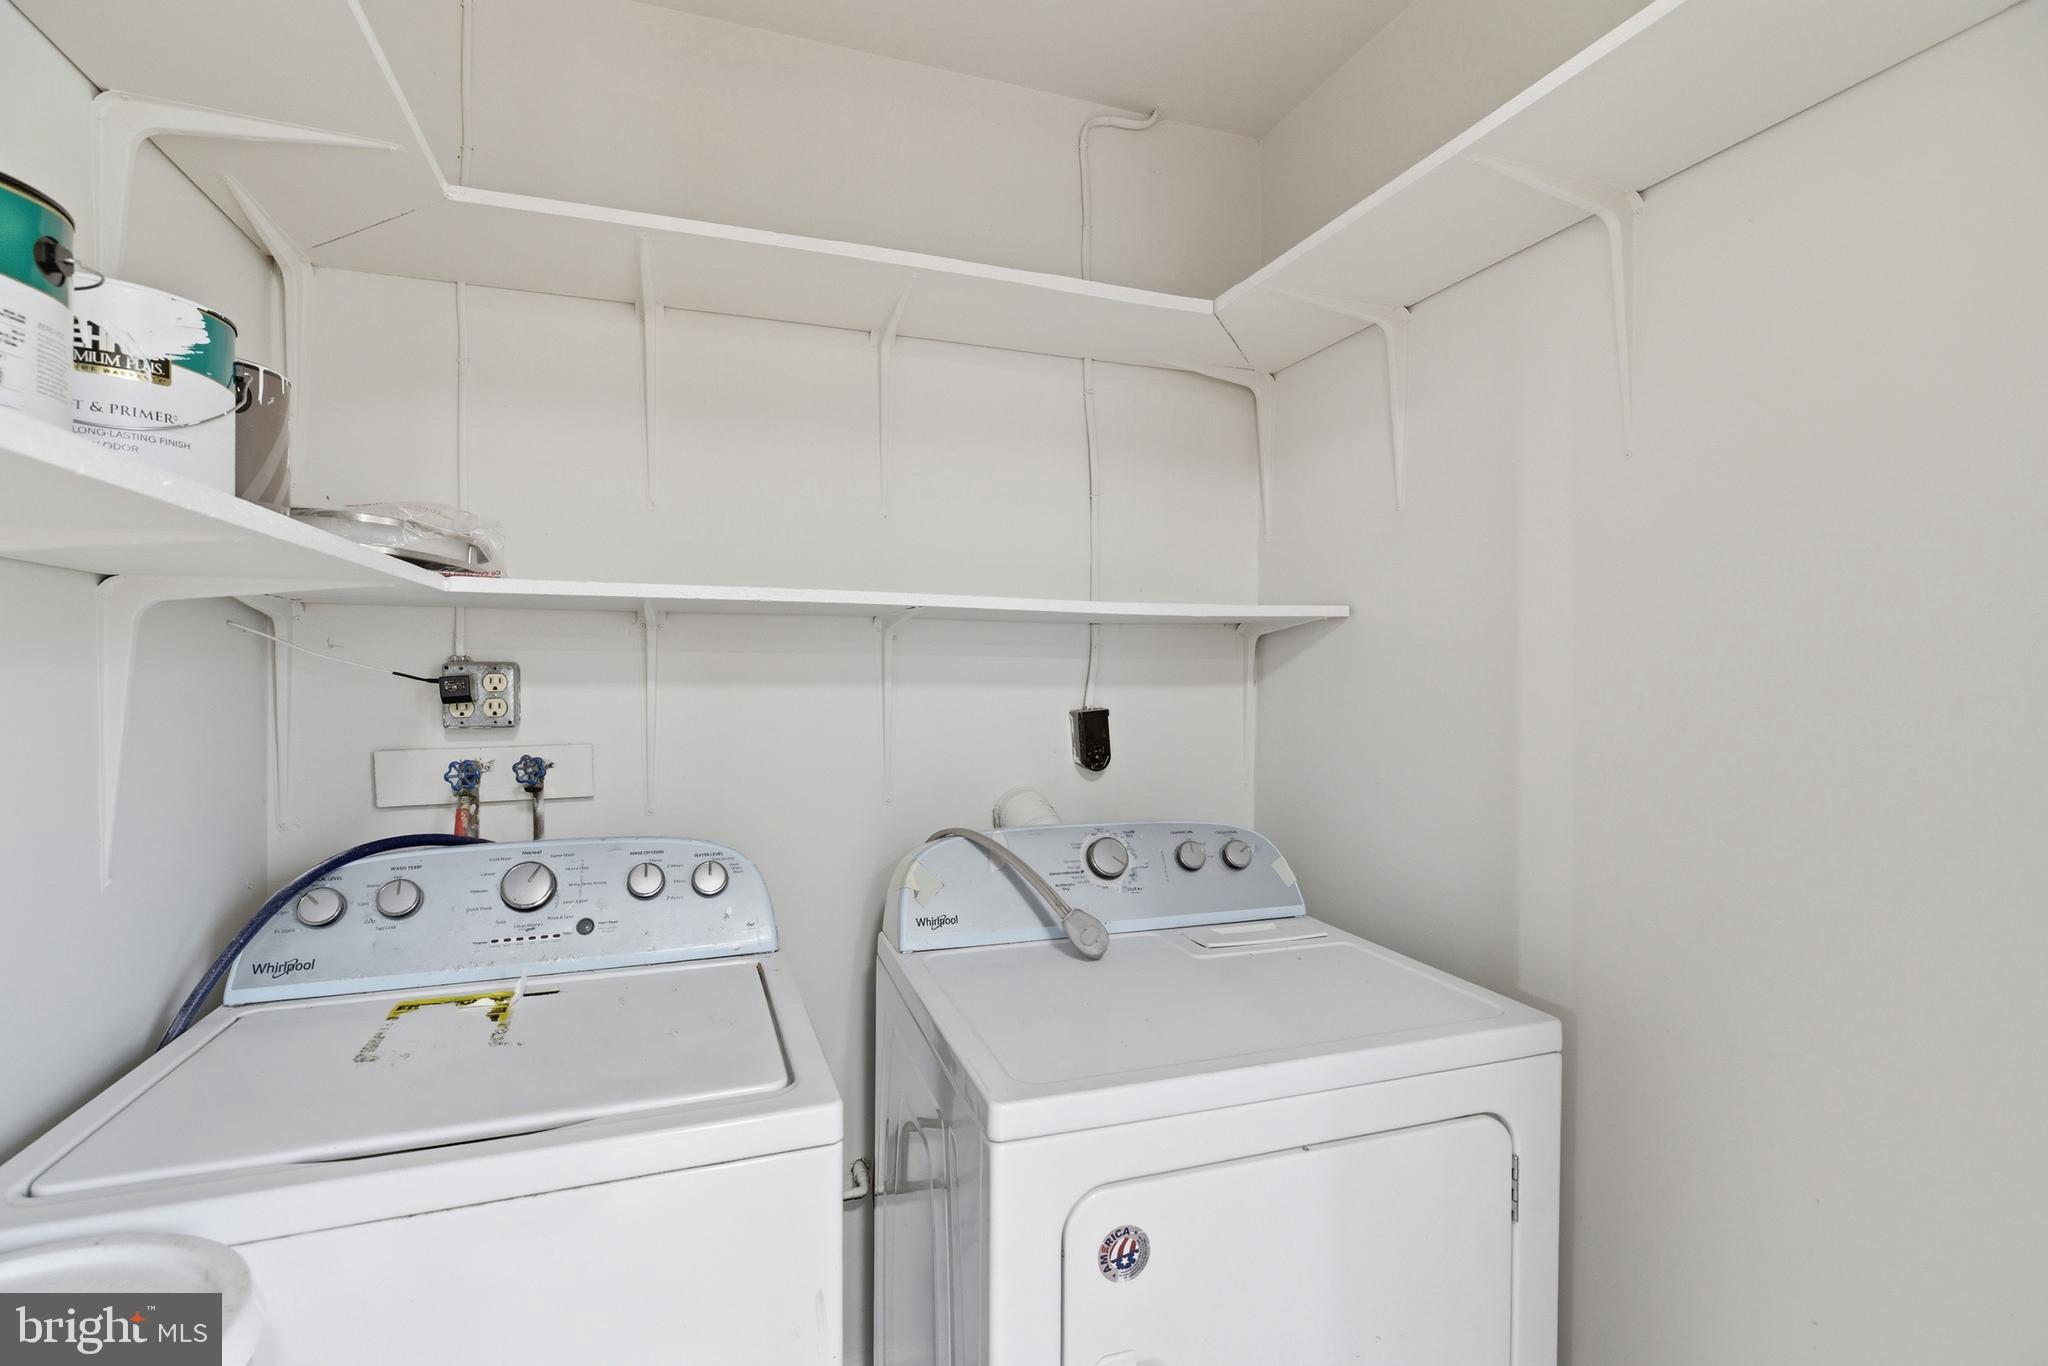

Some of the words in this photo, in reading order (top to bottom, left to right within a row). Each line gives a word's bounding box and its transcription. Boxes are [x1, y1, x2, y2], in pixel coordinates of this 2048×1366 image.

[89, 401, 103, 413] &
[110, 403, 175, 424] PRIMER
[160, 437, 191, 450] FINISH
[916, 914, 959, 930] Whirlpool
[252, 958, 315, 979] Whirlpool
[1100, 1227, 1130, 1273] AMERICA
